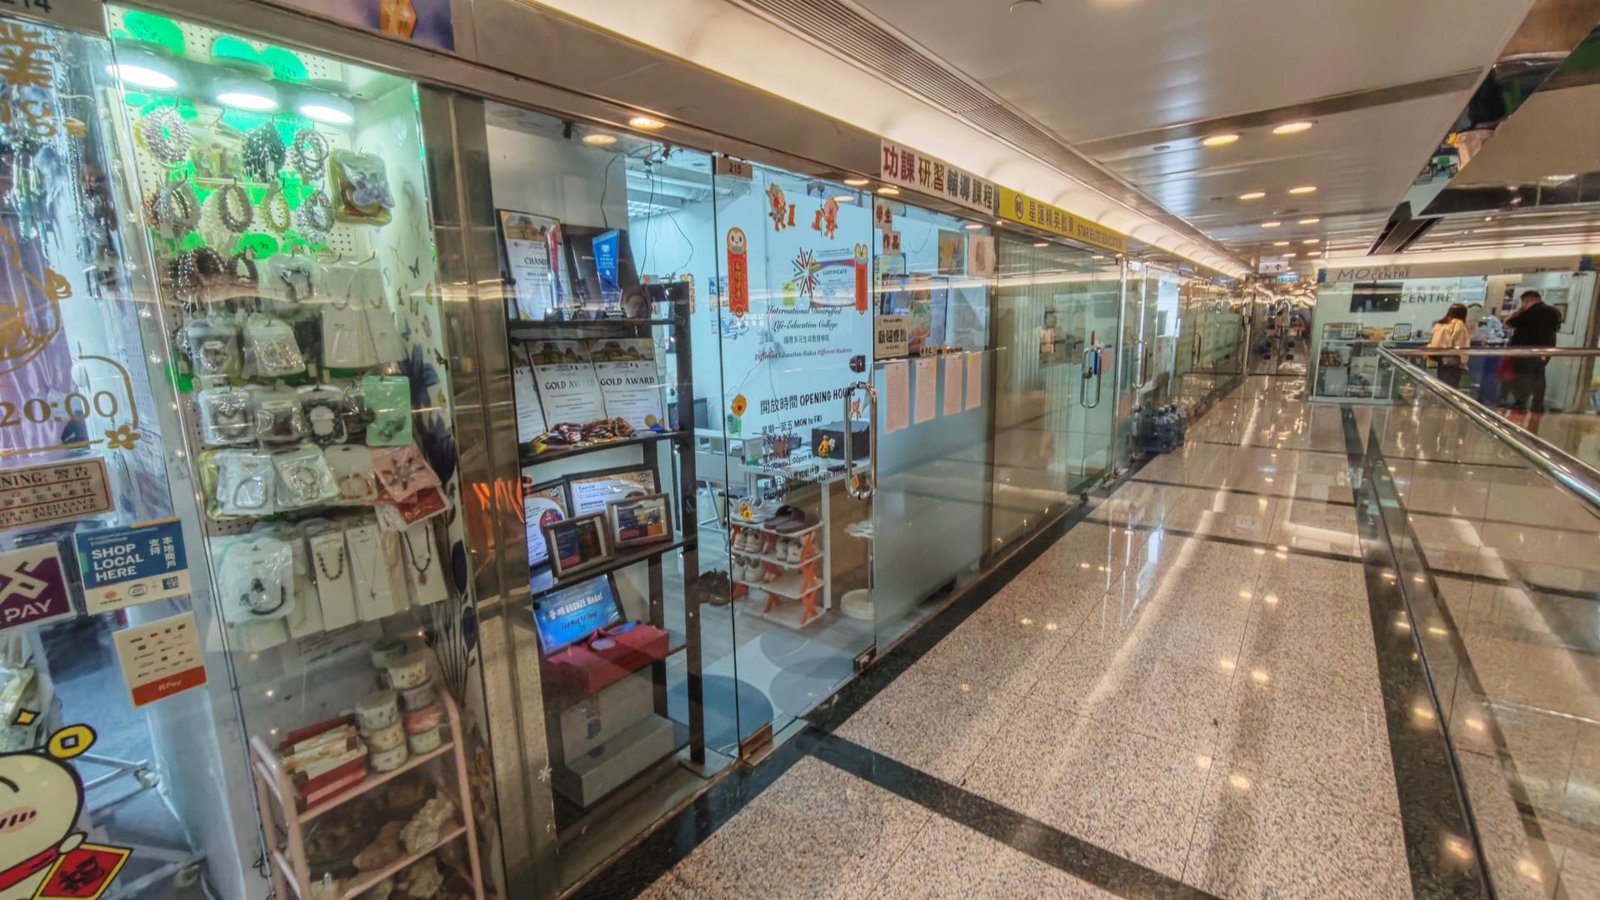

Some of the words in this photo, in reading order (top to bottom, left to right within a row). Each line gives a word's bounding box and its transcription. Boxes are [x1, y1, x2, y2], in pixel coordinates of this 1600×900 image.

[729, 162, 742, 175] 215
[883, 145, 993, 210] 功課研習輔導課程
[767, 304, 810, 315] International
[818, 320, 838, 331] College
[545, 380, 567, 391] GOLD
[600, 378, 623, 387] GOLD
[625, 376, 655, 386] AWARD
[0, 390, 118, 428] 20:00
[760, 395, 798, 415] 開放時間
[799, 390, 832, 407] OPENING
[793, 417, 807, 428] MON
[813, 414, 823, 424] FRI
[92, 543, 136, 559] SHOP
[148, 538, 161, 556] 支持
[162, 536, 177, 569] 本地商戶
[93, 553, 145, 571] LOCAL
[95, 565, 138, 582] HERE
[4, 598, 52, 622] PAY
